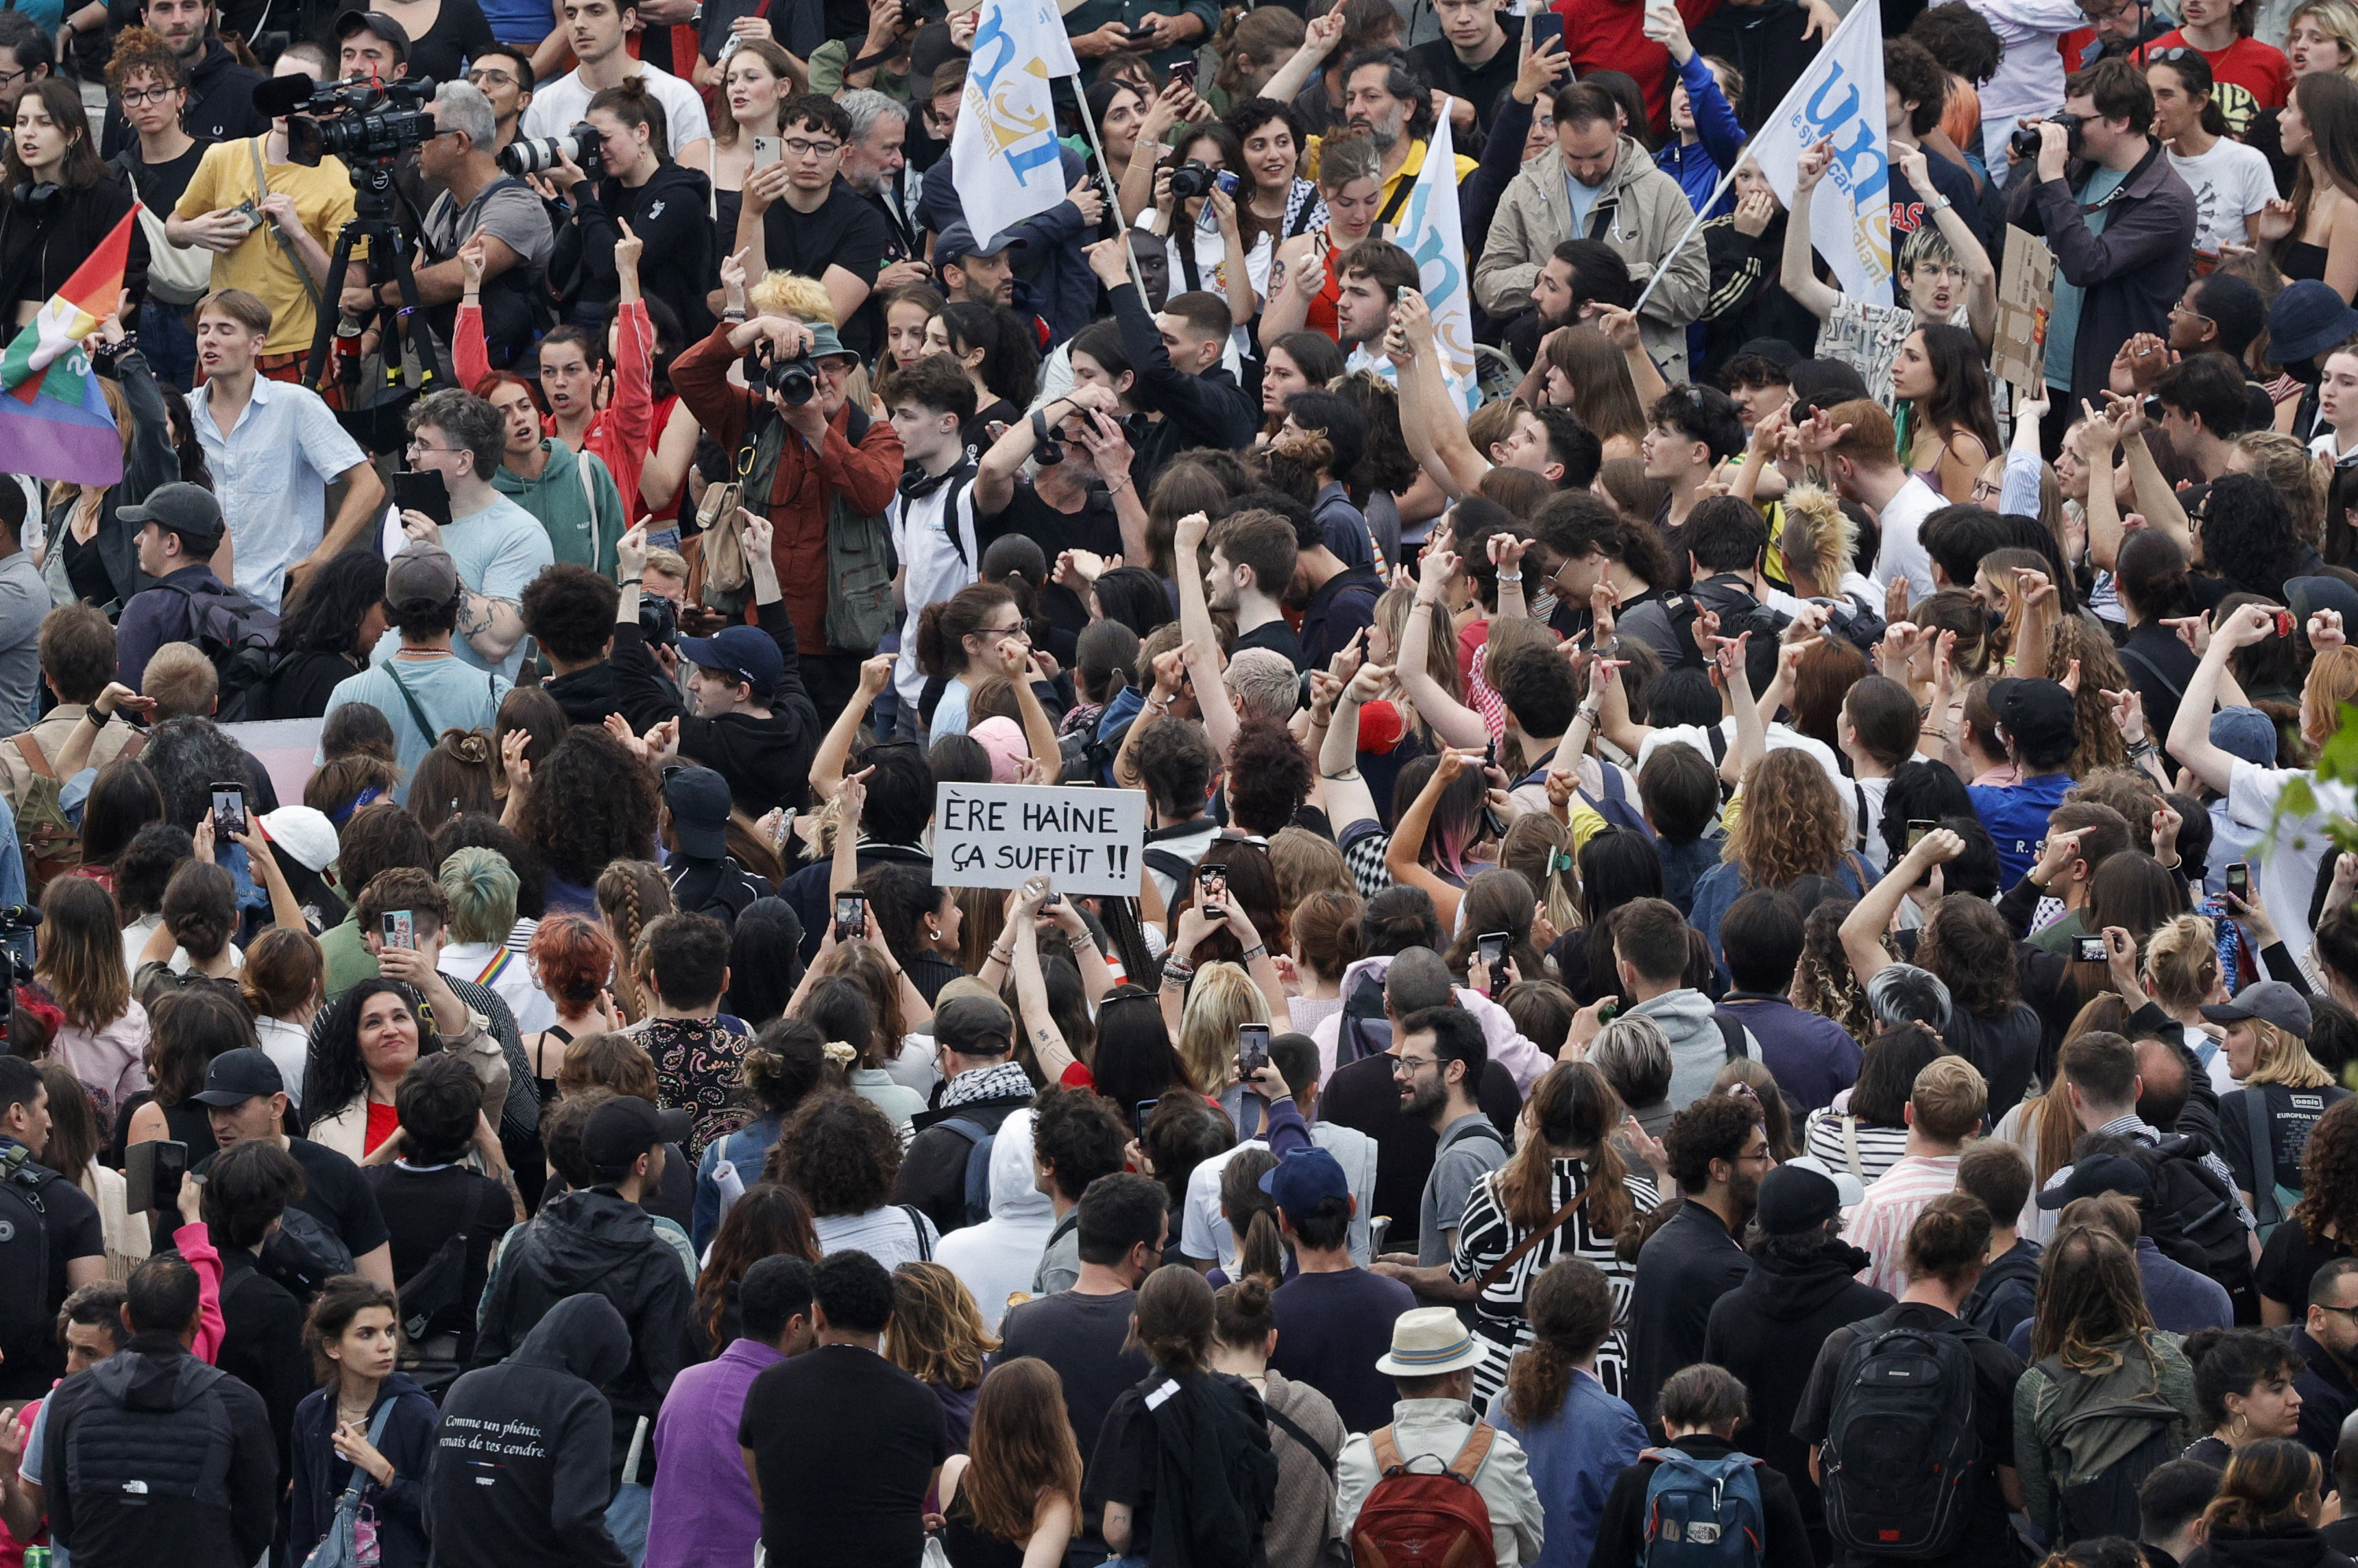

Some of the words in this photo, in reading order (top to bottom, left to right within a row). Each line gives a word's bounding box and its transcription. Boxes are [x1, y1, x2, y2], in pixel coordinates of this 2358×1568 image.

[1790, 106, 1802, 128] le
[944, 789, 1008, 831] ÈRE
[2015, 840, 2030, 854] R.
[951, 843, 986, 872] ÇA
[1106, 844, 1129, 880] !!
[446, 1414, 482, 1429] Comme
[483, 1420, 500, 1432] un
[468, 1434, 483, 1450] de
[485, 1439, 502, 1452] tes
[503, 1441, 546, 1458] cendre.
